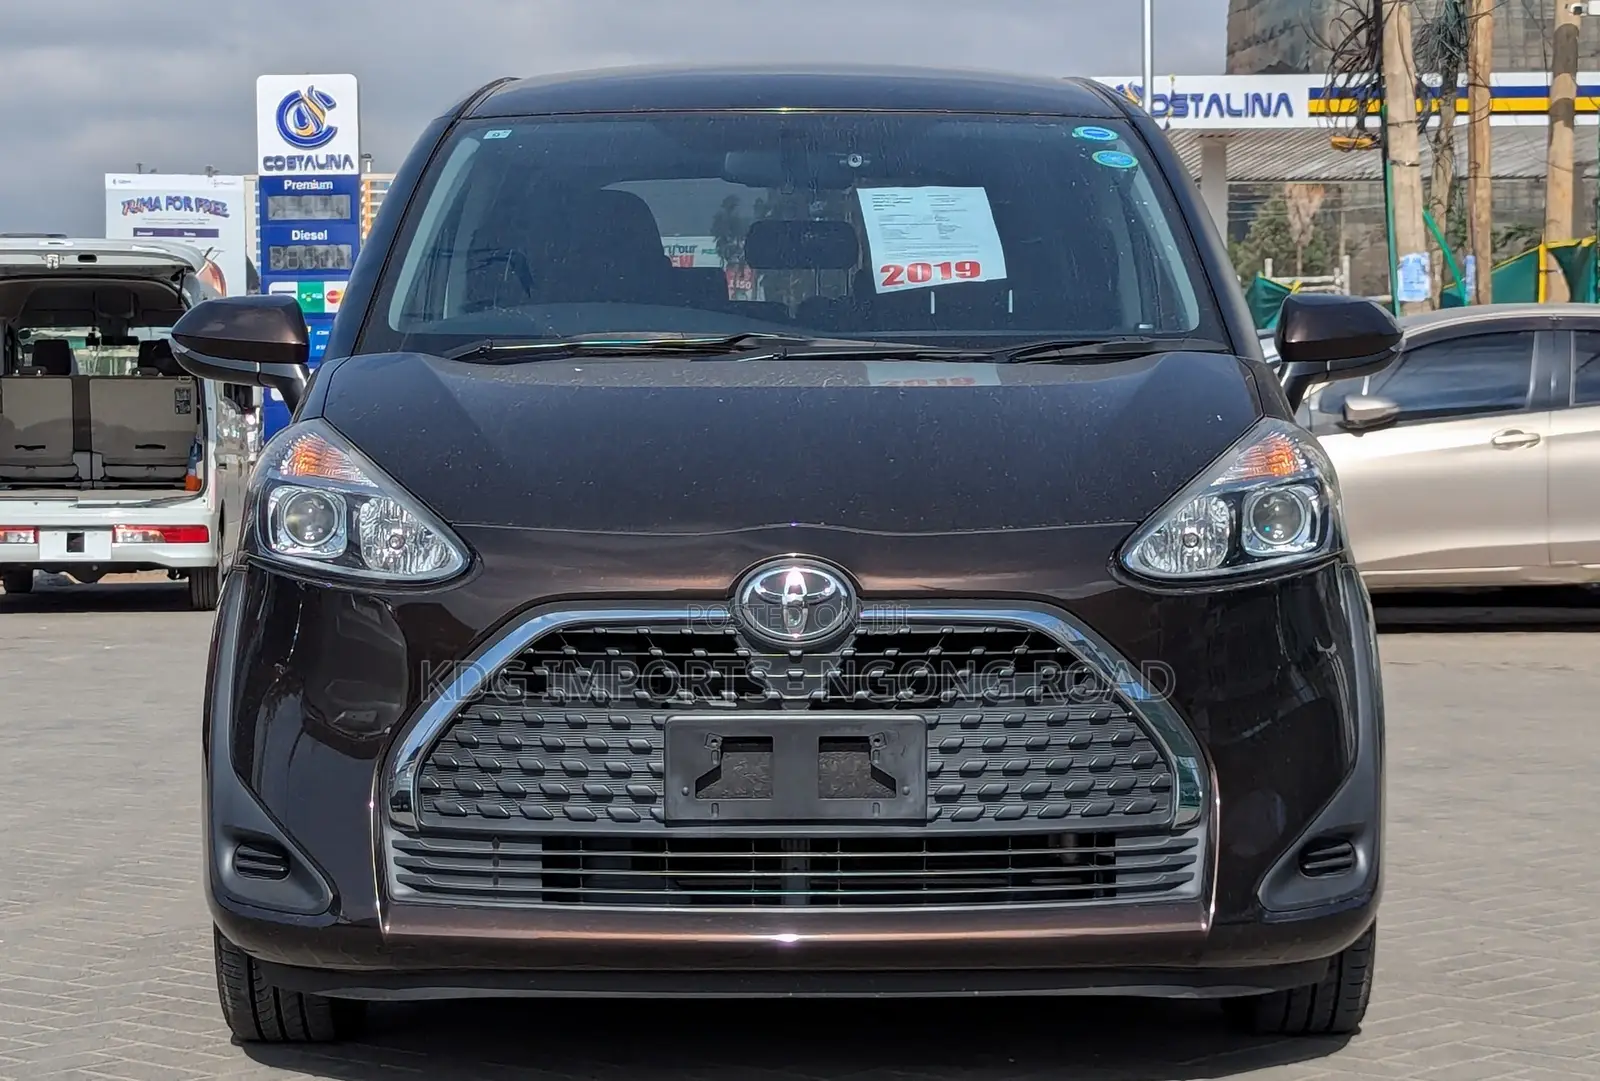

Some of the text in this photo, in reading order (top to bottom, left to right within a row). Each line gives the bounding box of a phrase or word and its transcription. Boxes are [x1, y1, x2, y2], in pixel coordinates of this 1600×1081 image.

[1148, 93, 1294, 118] OSTALINA
[263, 154, 354, 172] COSTALINA
[284, 180, 333, 190] Premium
[165, 195, 194, 212] FOR
[291, 230, 328, 241] Diesel
[880, 260, 981, 287] 2019
